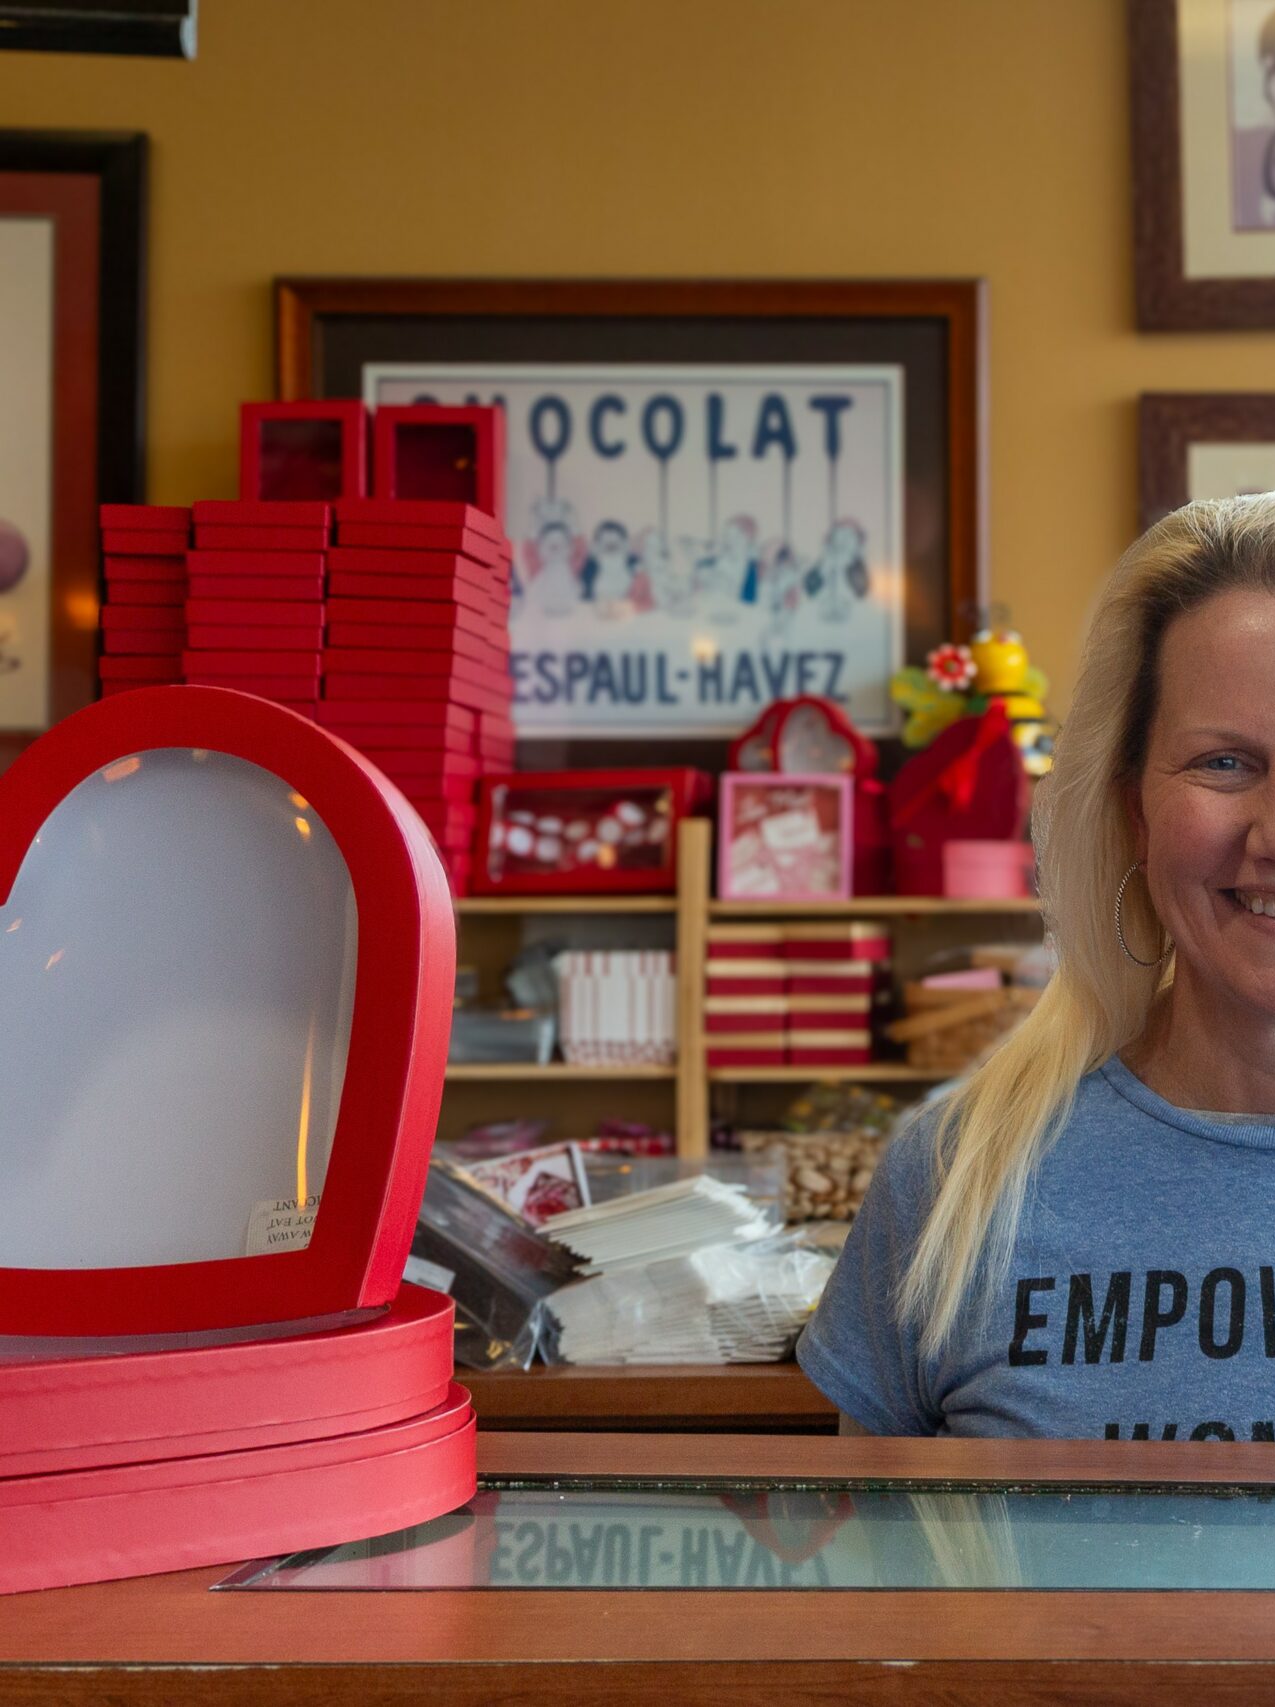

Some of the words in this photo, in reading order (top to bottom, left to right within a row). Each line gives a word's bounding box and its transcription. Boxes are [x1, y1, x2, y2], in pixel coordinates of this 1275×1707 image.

[410, 392, 854, 461] OCOLAT
[272, 1195, 321, 1212] ICANT
[266, 1217, 291, 1230] EAT
[296, 1215, 317, 1226] OT
